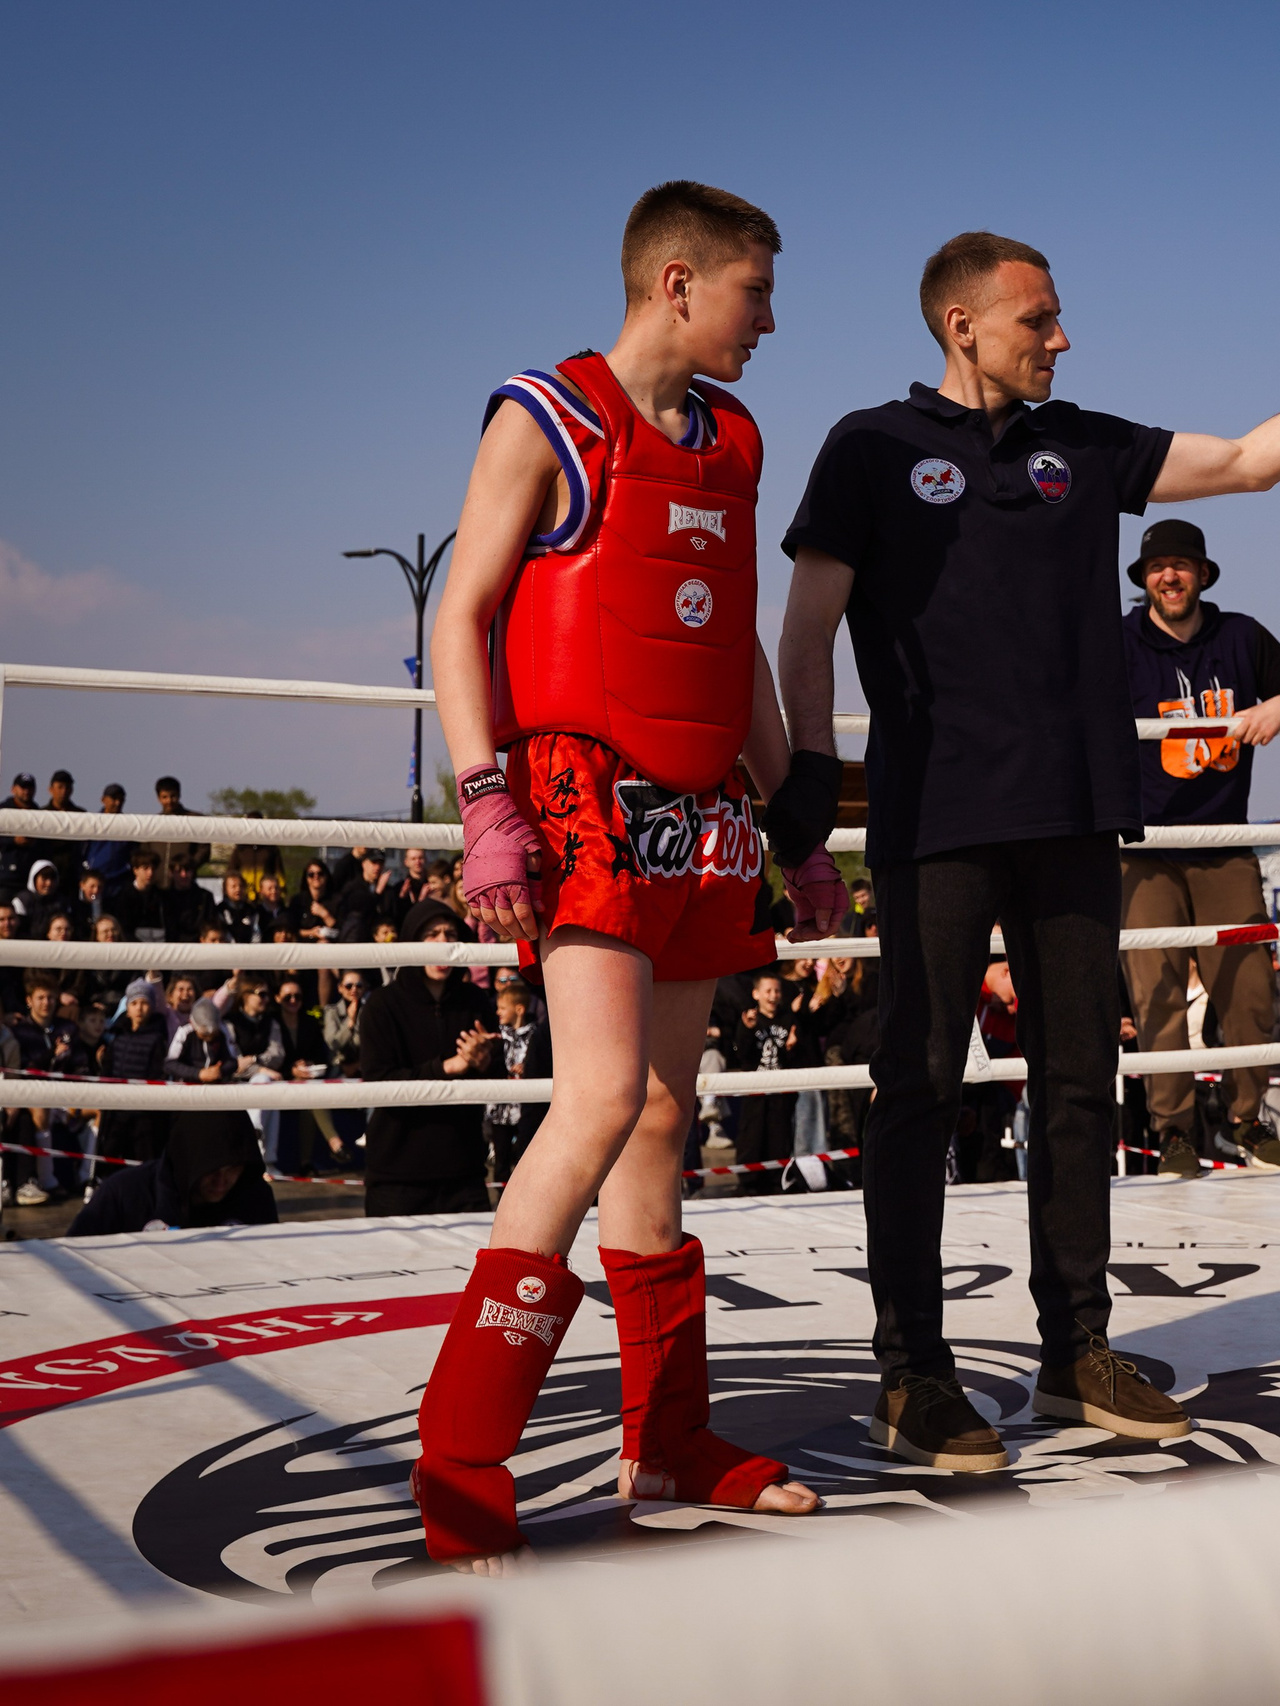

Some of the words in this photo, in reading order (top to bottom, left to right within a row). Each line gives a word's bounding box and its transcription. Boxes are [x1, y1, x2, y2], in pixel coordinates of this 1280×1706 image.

[668, 501, 726, 543] REYVEL
[464, 773, 505, 795] TWINS
[475, 1297, 557, 1347] REYVEL
